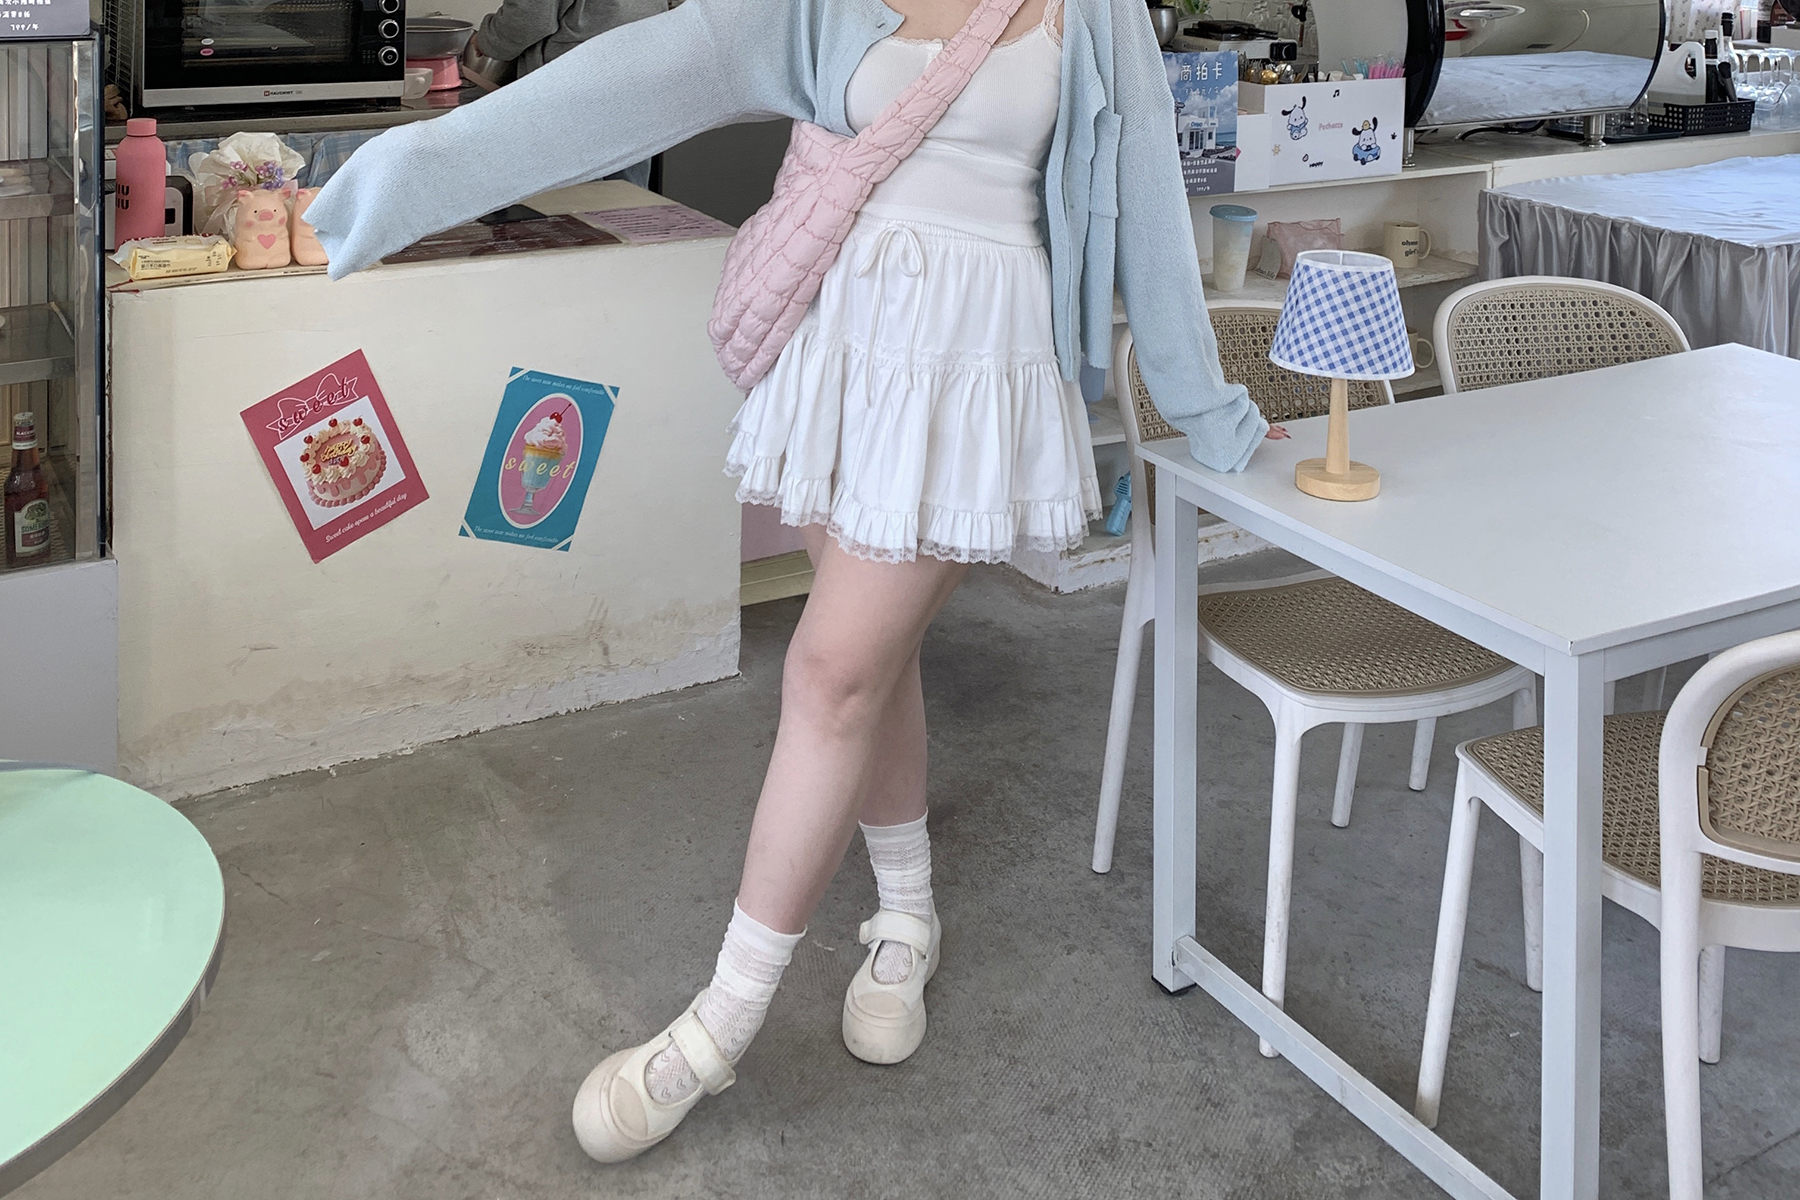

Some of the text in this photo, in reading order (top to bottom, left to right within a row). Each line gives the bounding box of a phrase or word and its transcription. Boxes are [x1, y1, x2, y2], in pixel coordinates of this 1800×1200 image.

[1181, 61, 1223, 81] 商拍卡
[277, 376, 350, 432] sweet
[505, 456, 576, 479] sweet
[325, 528, 342, 543] Sweet
